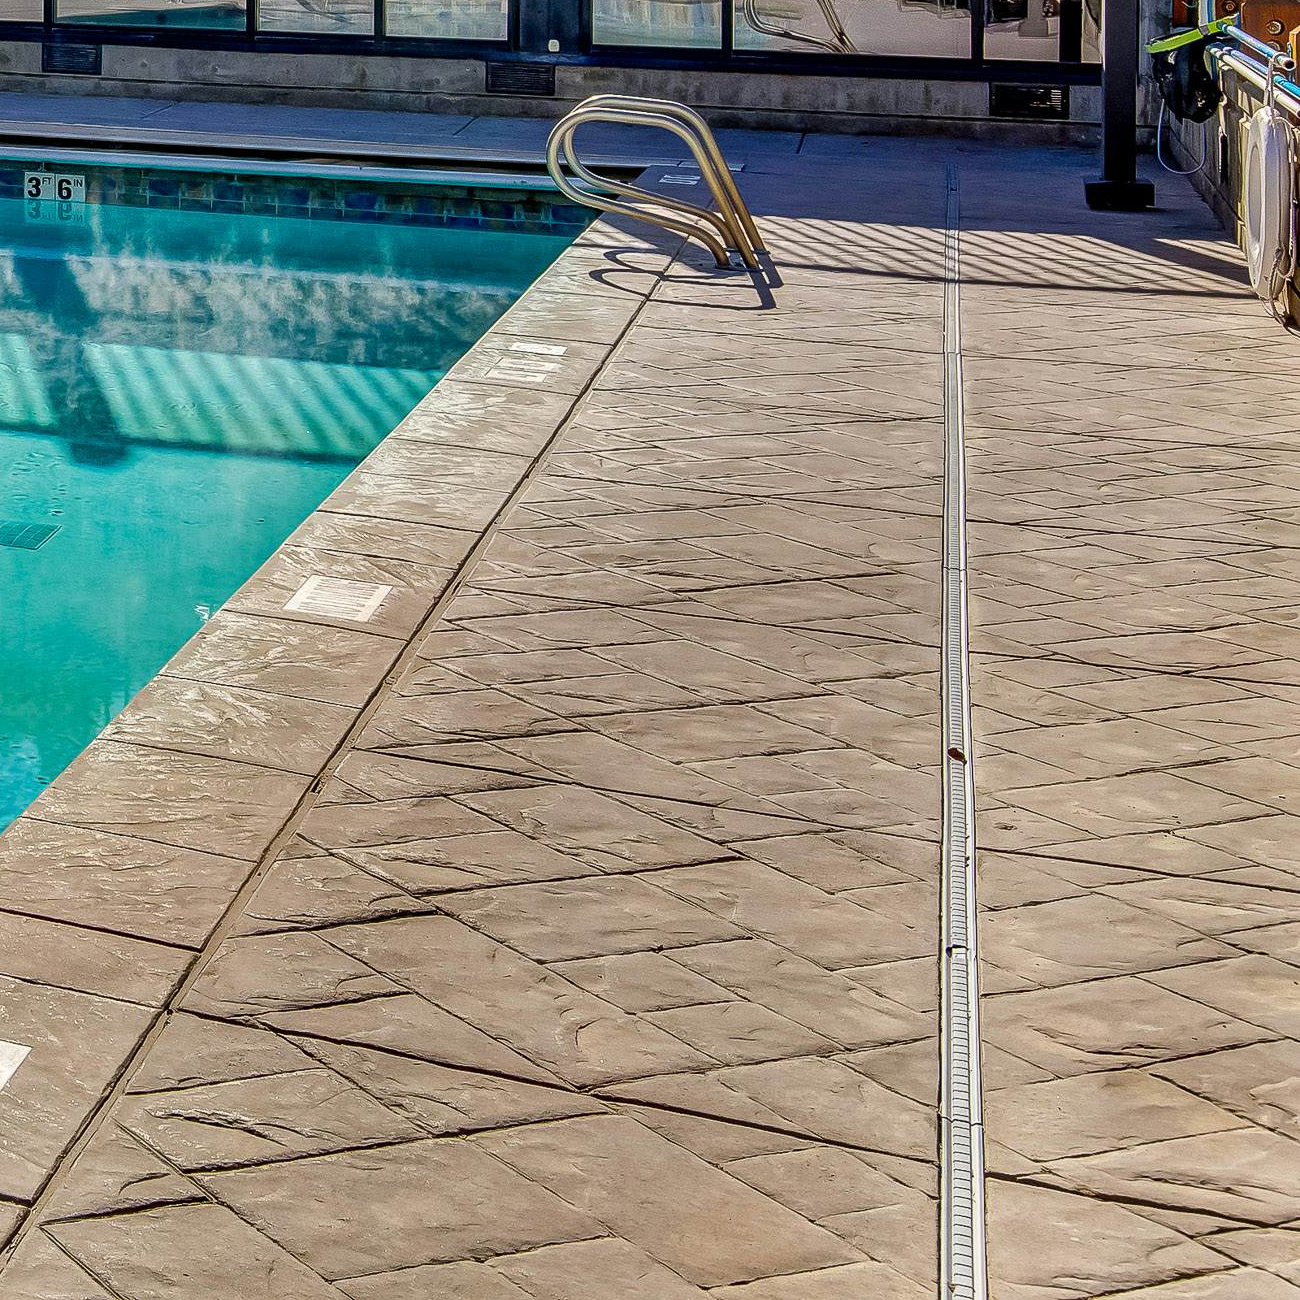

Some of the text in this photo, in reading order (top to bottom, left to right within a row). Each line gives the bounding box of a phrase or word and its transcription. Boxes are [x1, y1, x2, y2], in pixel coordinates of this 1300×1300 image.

[27, 176, 83, 200] 3 FT 6 IN
